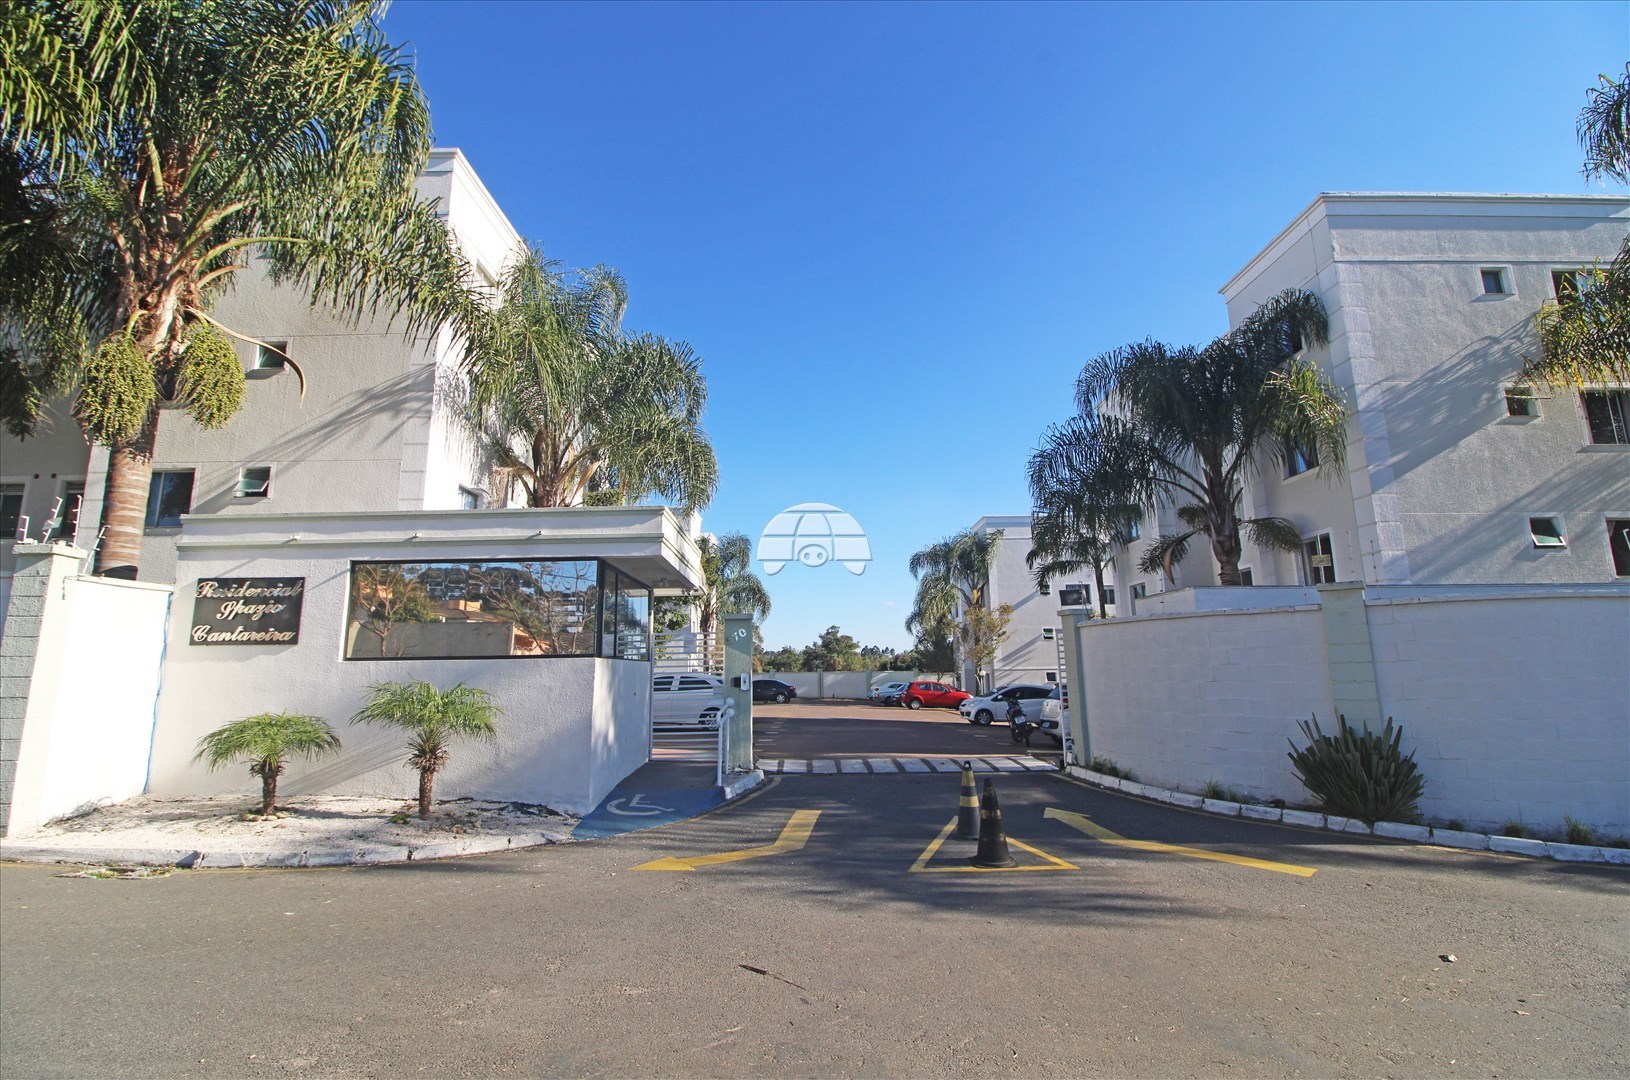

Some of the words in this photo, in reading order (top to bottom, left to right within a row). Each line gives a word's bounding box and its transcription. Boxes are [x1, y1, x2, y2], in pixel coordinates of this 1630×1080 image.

[195, 580, 303, 598] Residencial
[216, 599, 287, 621] Spazio
[192, 624, 296, 642] Cantareira
